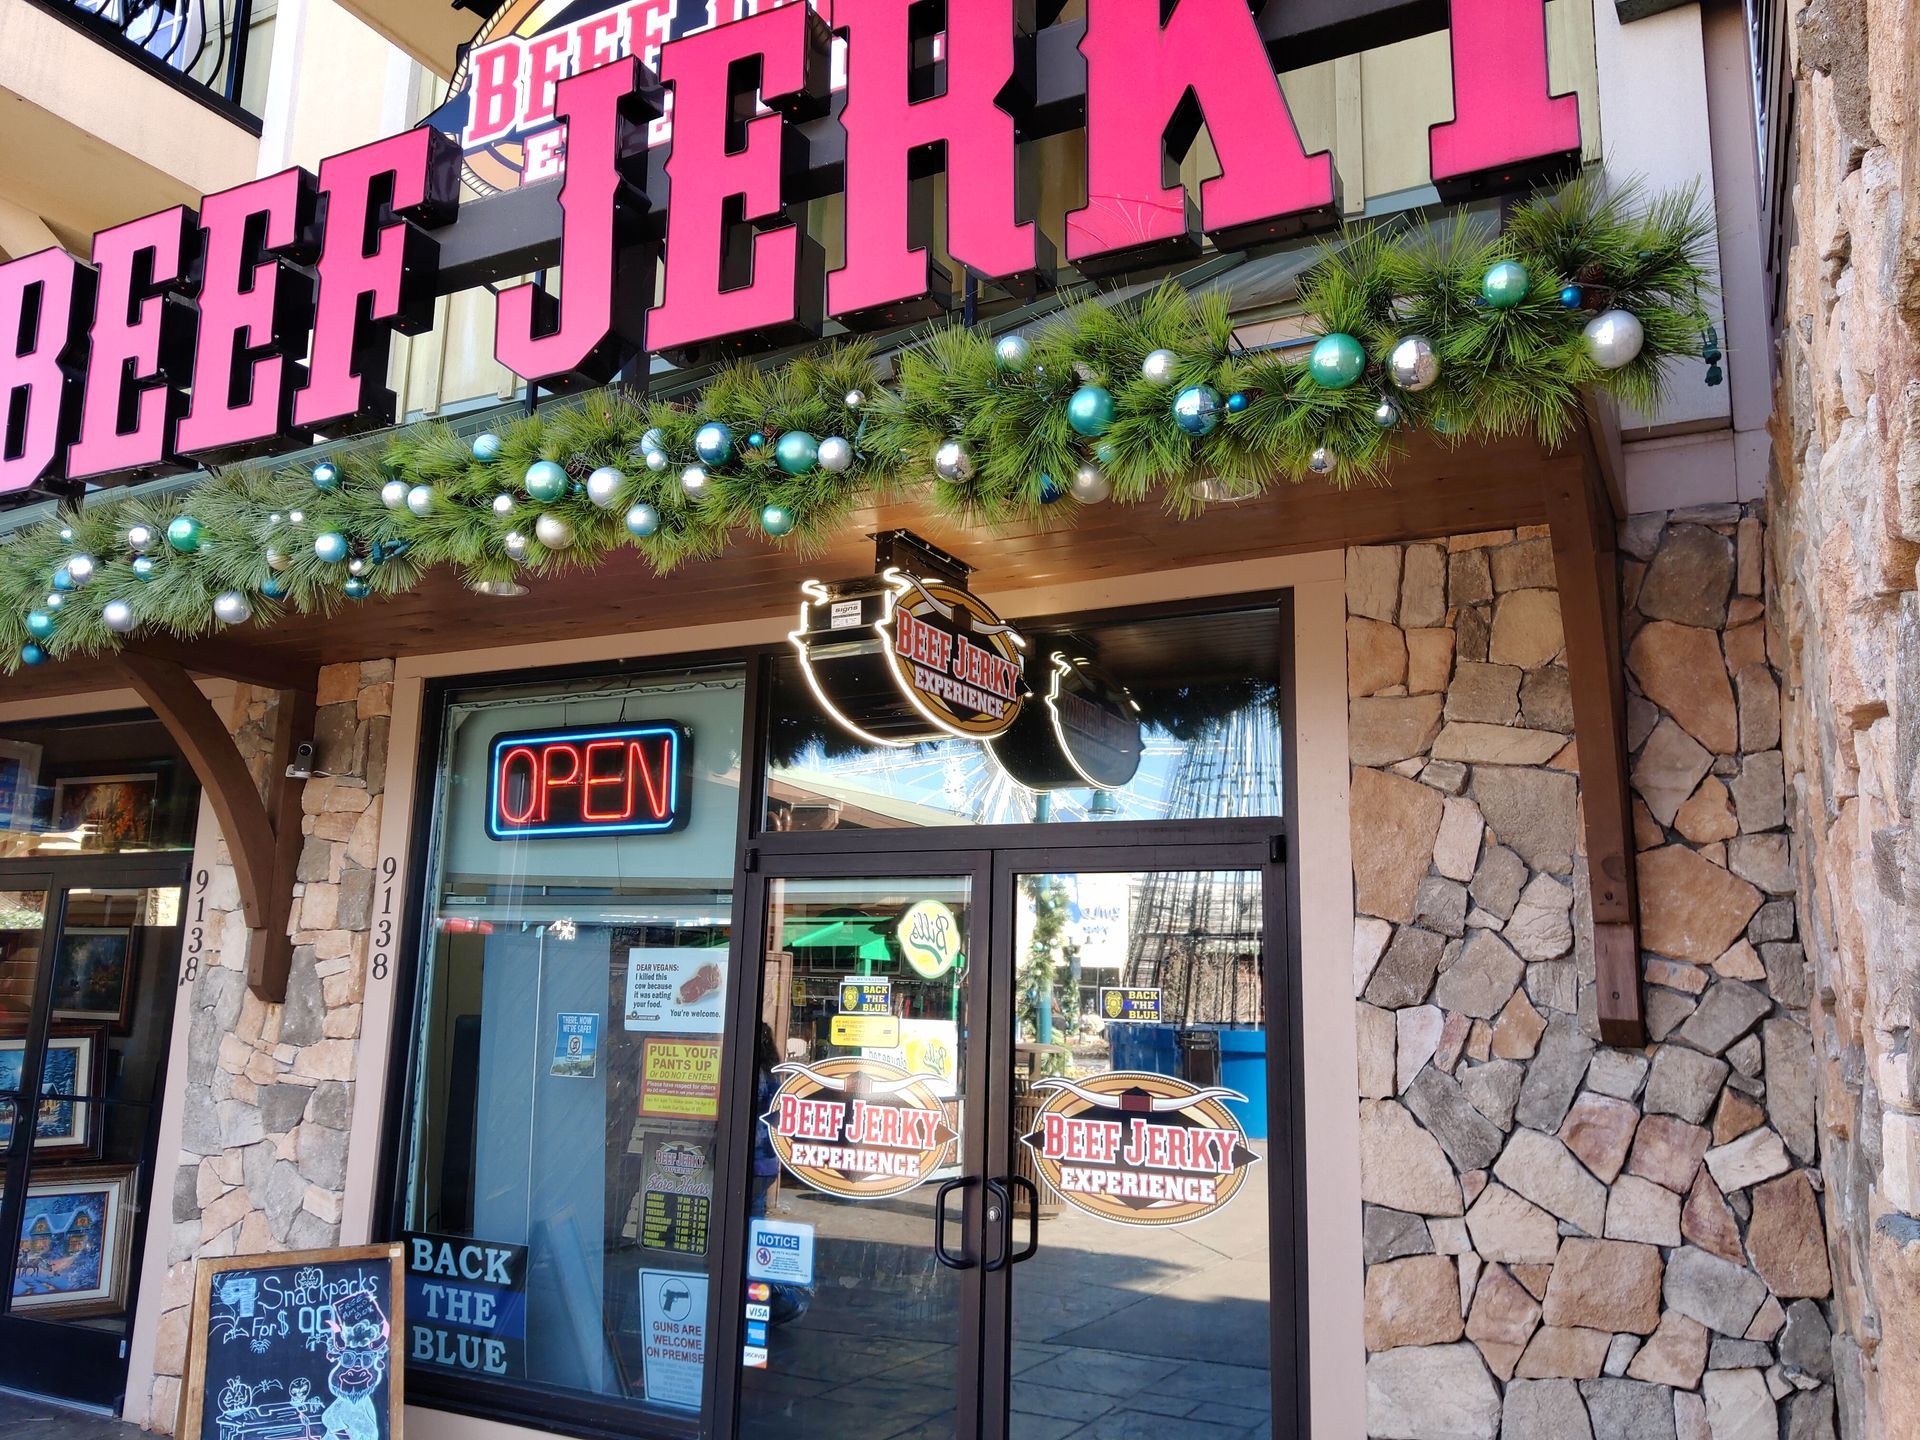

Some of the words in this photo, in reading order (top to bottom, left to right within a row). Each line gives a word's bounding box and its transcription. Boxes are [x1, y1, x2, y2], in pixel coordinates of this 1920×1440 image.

[0, 124, 433, 496] BEEF
[896, 607, 953, 674] BEEF
[953, 634, 1020, 702] JERKY
[914, 665, 1004, 720] EXPERIENCE
[500, 738, 671, 823] OPEN
[636, 963, 652, 972] DEAR
[653, 963, 680, 972] VEGANS:
[639, 972, 655, 981] killed
[655, 972, 668, 981] this
[647, 982, 672, 990] because
[863, 986, 888, 994] BACK
[633, 991, 639, 999] it
[651, 992, 672, 1000] eating
[865, 994, 885, 1003] THE
[1128, 991, 1159, 1000] BACK
[632, 1001, 646, 1009] your
[646, 1000, 662, 1009] food.
[862, 1004, 887, 1012] BLUE
[1131, 1000, 1155, 1011] THE
[670, 1008, 690, 1018] You're
[691, 1009, 721, 1018] welcome.
[1128, 1010, 1159, 1020] BLUE
[649, 1045, 679, 1057] PULL
[684, 1047, 719, 1059] YOUR
[653, 1058, 691, 1071] PANTS
[695, 1060, 712, 1072] UP
[649, 1070, 660, 1078] Or
[659, 1071, 670, 1079] DO
[670, 1071, 687, 1080] NOT
[688, 1072, 715, 1081] ENTER!
[674, 1082, 692, 1090] respect
[779, 1093, 846, 1142] BEEF
[845, 1099, 942, 1151] JERKY
[1042, 1112, 1122, 1164] BEEF
[1123, 1118, 1239, 1175] JERKY
[655, 1150, 677, 1166] BEEF
[676, 1152, 705, 1169] JERKY
[790, 1142, 921, 1179] EXPERIENCE
[646, 1173, 674, 1190] Store
[675, 1176, 711, 1196] Hours
[1059, 1166, 1217, 1205] EXPERIENCE
[758, 1233, 798, 1249] NOTICE
[411, 1237, 512, 1286] BACK
[258, 1267, 380, 1310] Snackpacks
[421, 1282, 499, 1330] THE
[749, 1307, 769, 1319] VISA
[251, 1316, 277, 1337] For
[652, 1320, 680, 1334] GUNS
[681, 1324, 702, 1336] ARE
[411, 1324, 508, 1375] BLUE
[653, 1334, 702, 1350] WELCOME
[646, 1346, 660, 1358] ON
